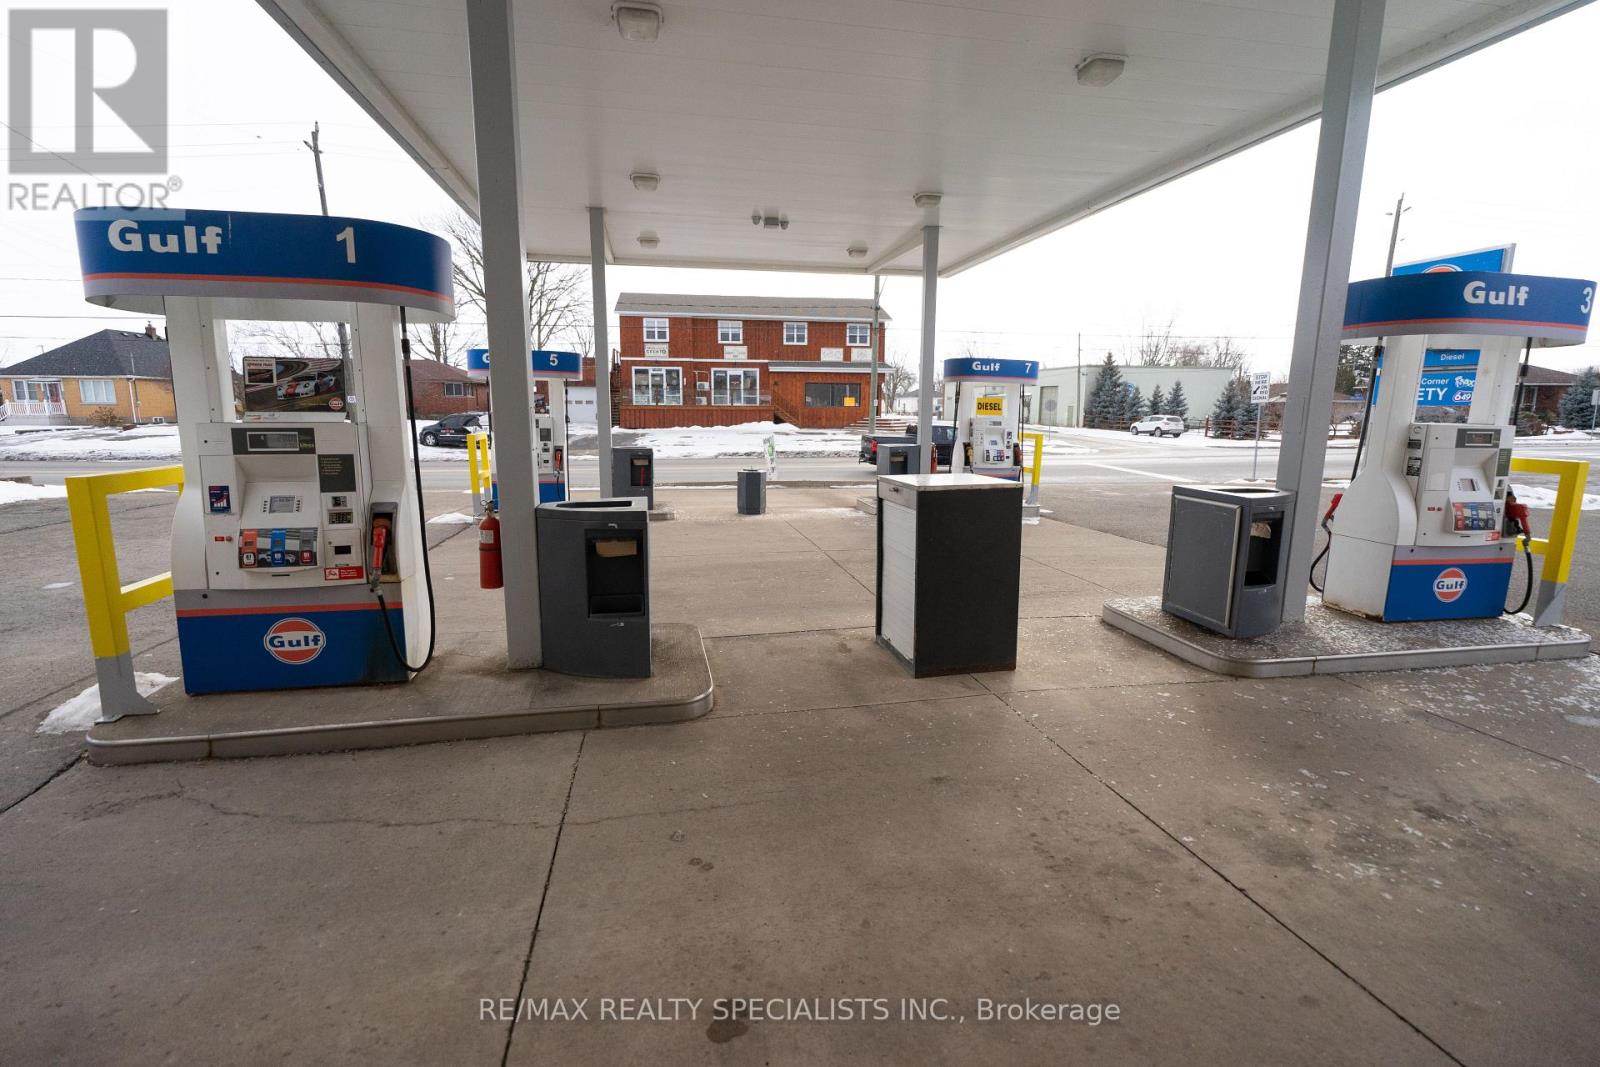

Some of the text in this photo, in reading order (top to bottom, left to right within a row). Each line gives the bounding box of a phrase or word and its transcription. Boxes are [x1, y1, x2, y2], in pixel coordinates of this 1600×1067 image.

[107, 218, 223, 255] Gulf
[335, 226, 357, 264] 1
[1463, 280, 1529, 306] Gulf
[1580, 286, 1593, 314] 3
[549, 353, 559, 367] 5
[1440, 353, 1465, 361] Diesel
[972, 361, 1000, 371] Gulf
[1025, 362, 1032, 374] 7
[1421, 377, 1450, 385] Corner
[977, 402, 1002, 411] DIESEL
[1436, 580, 1464, 590] Gulf
[268, 635, 321, 648] Gulf
